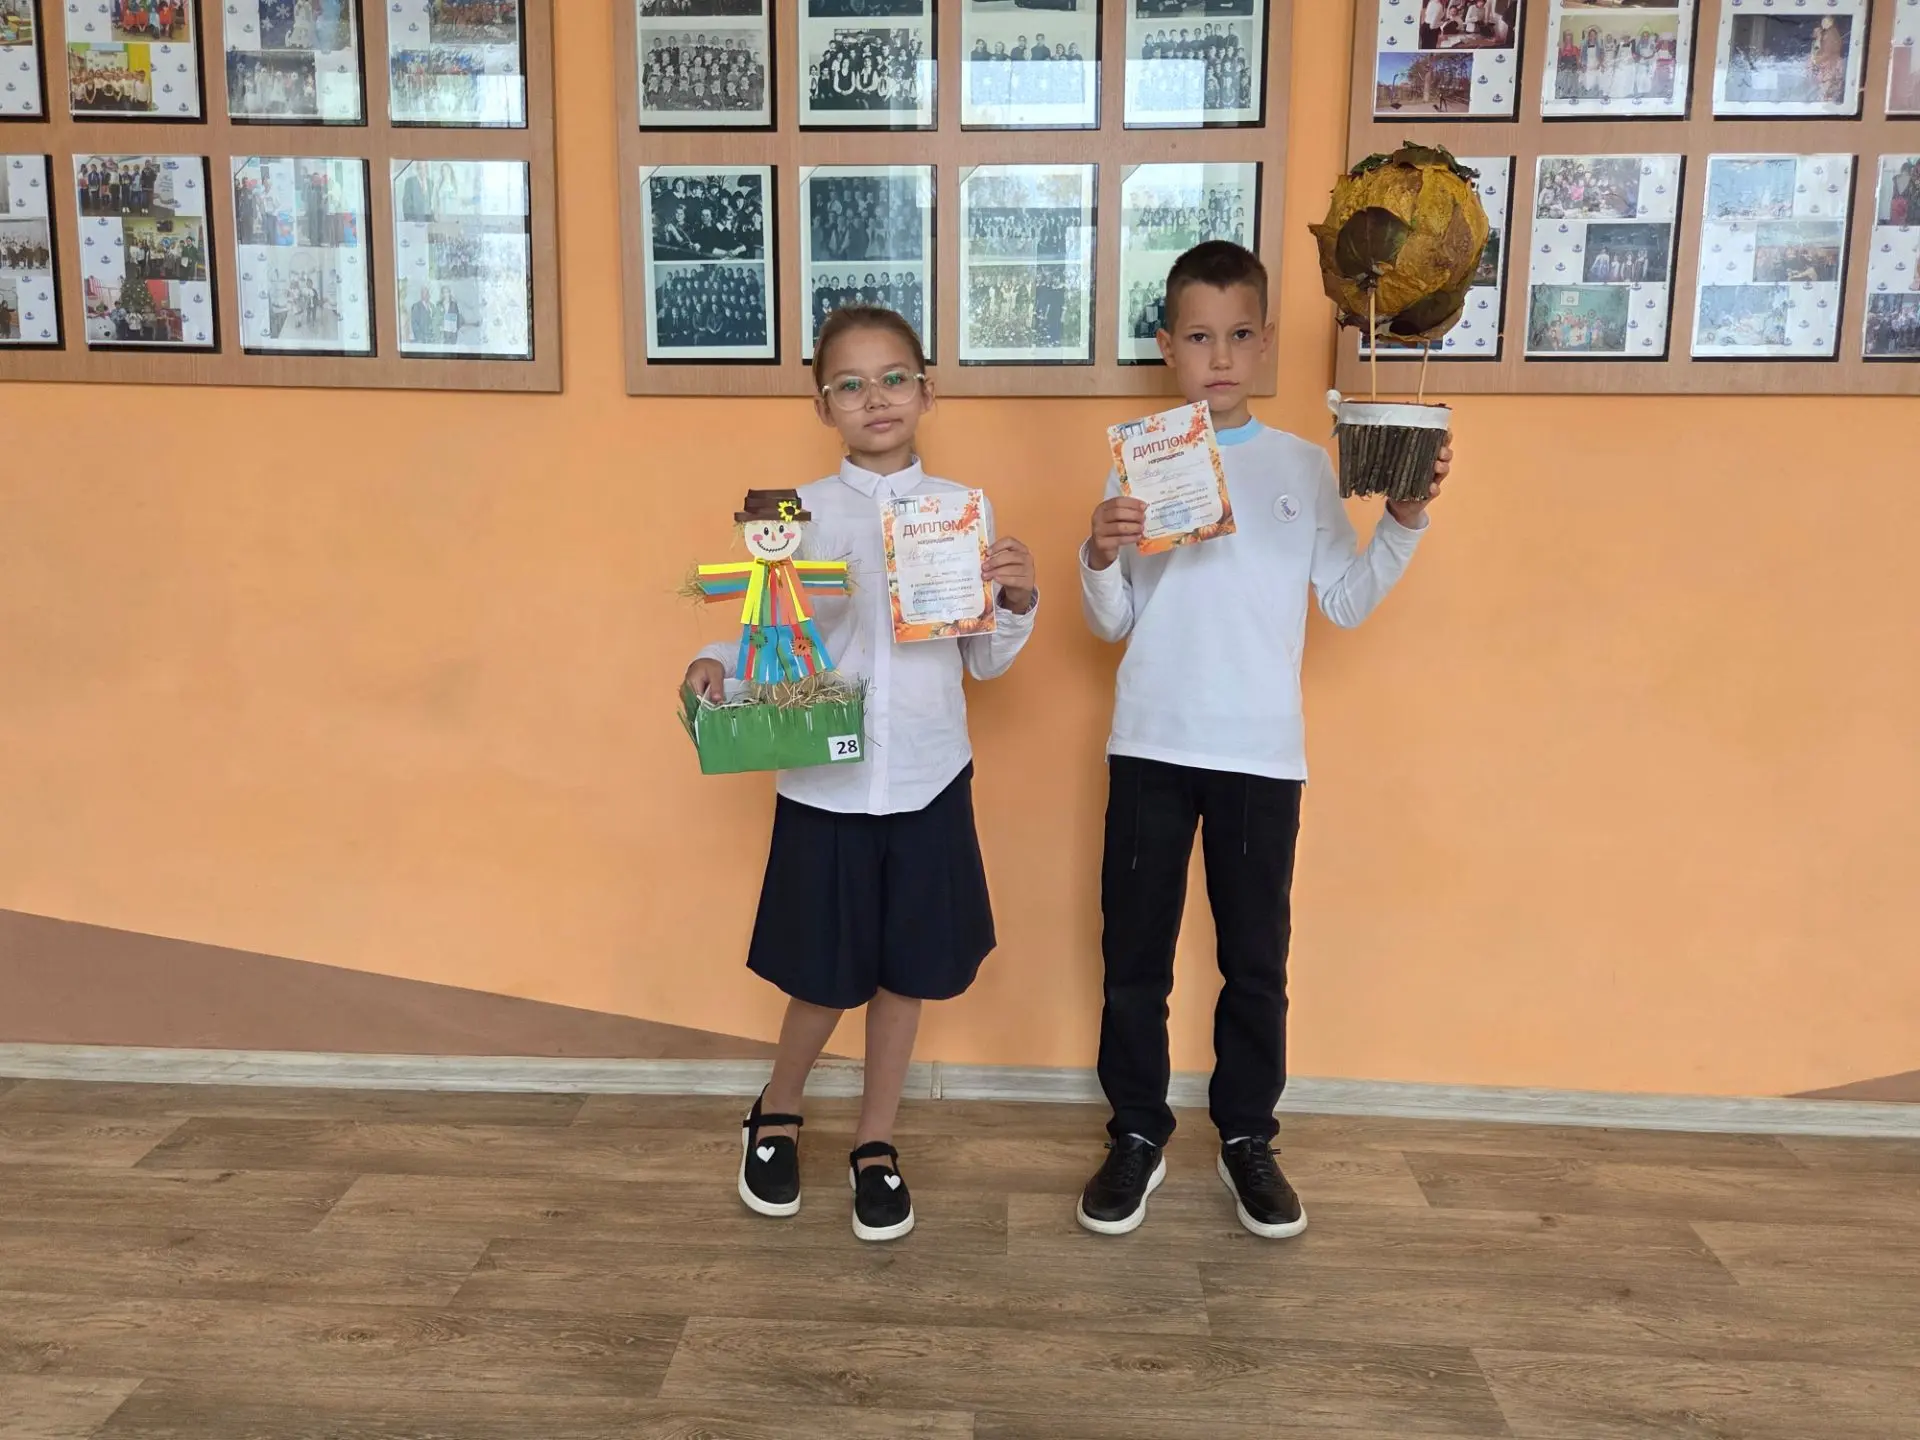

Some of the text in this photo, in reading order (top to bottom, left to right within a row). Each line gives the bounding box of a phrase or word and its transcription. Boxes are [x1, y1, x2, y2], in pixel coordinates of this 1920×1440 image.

[1132, 434, 1192, 461] ДИПЛОМ
[902, 519, 964, 538] ДИПЛОМ
[836, 739, 858, 755] 28
